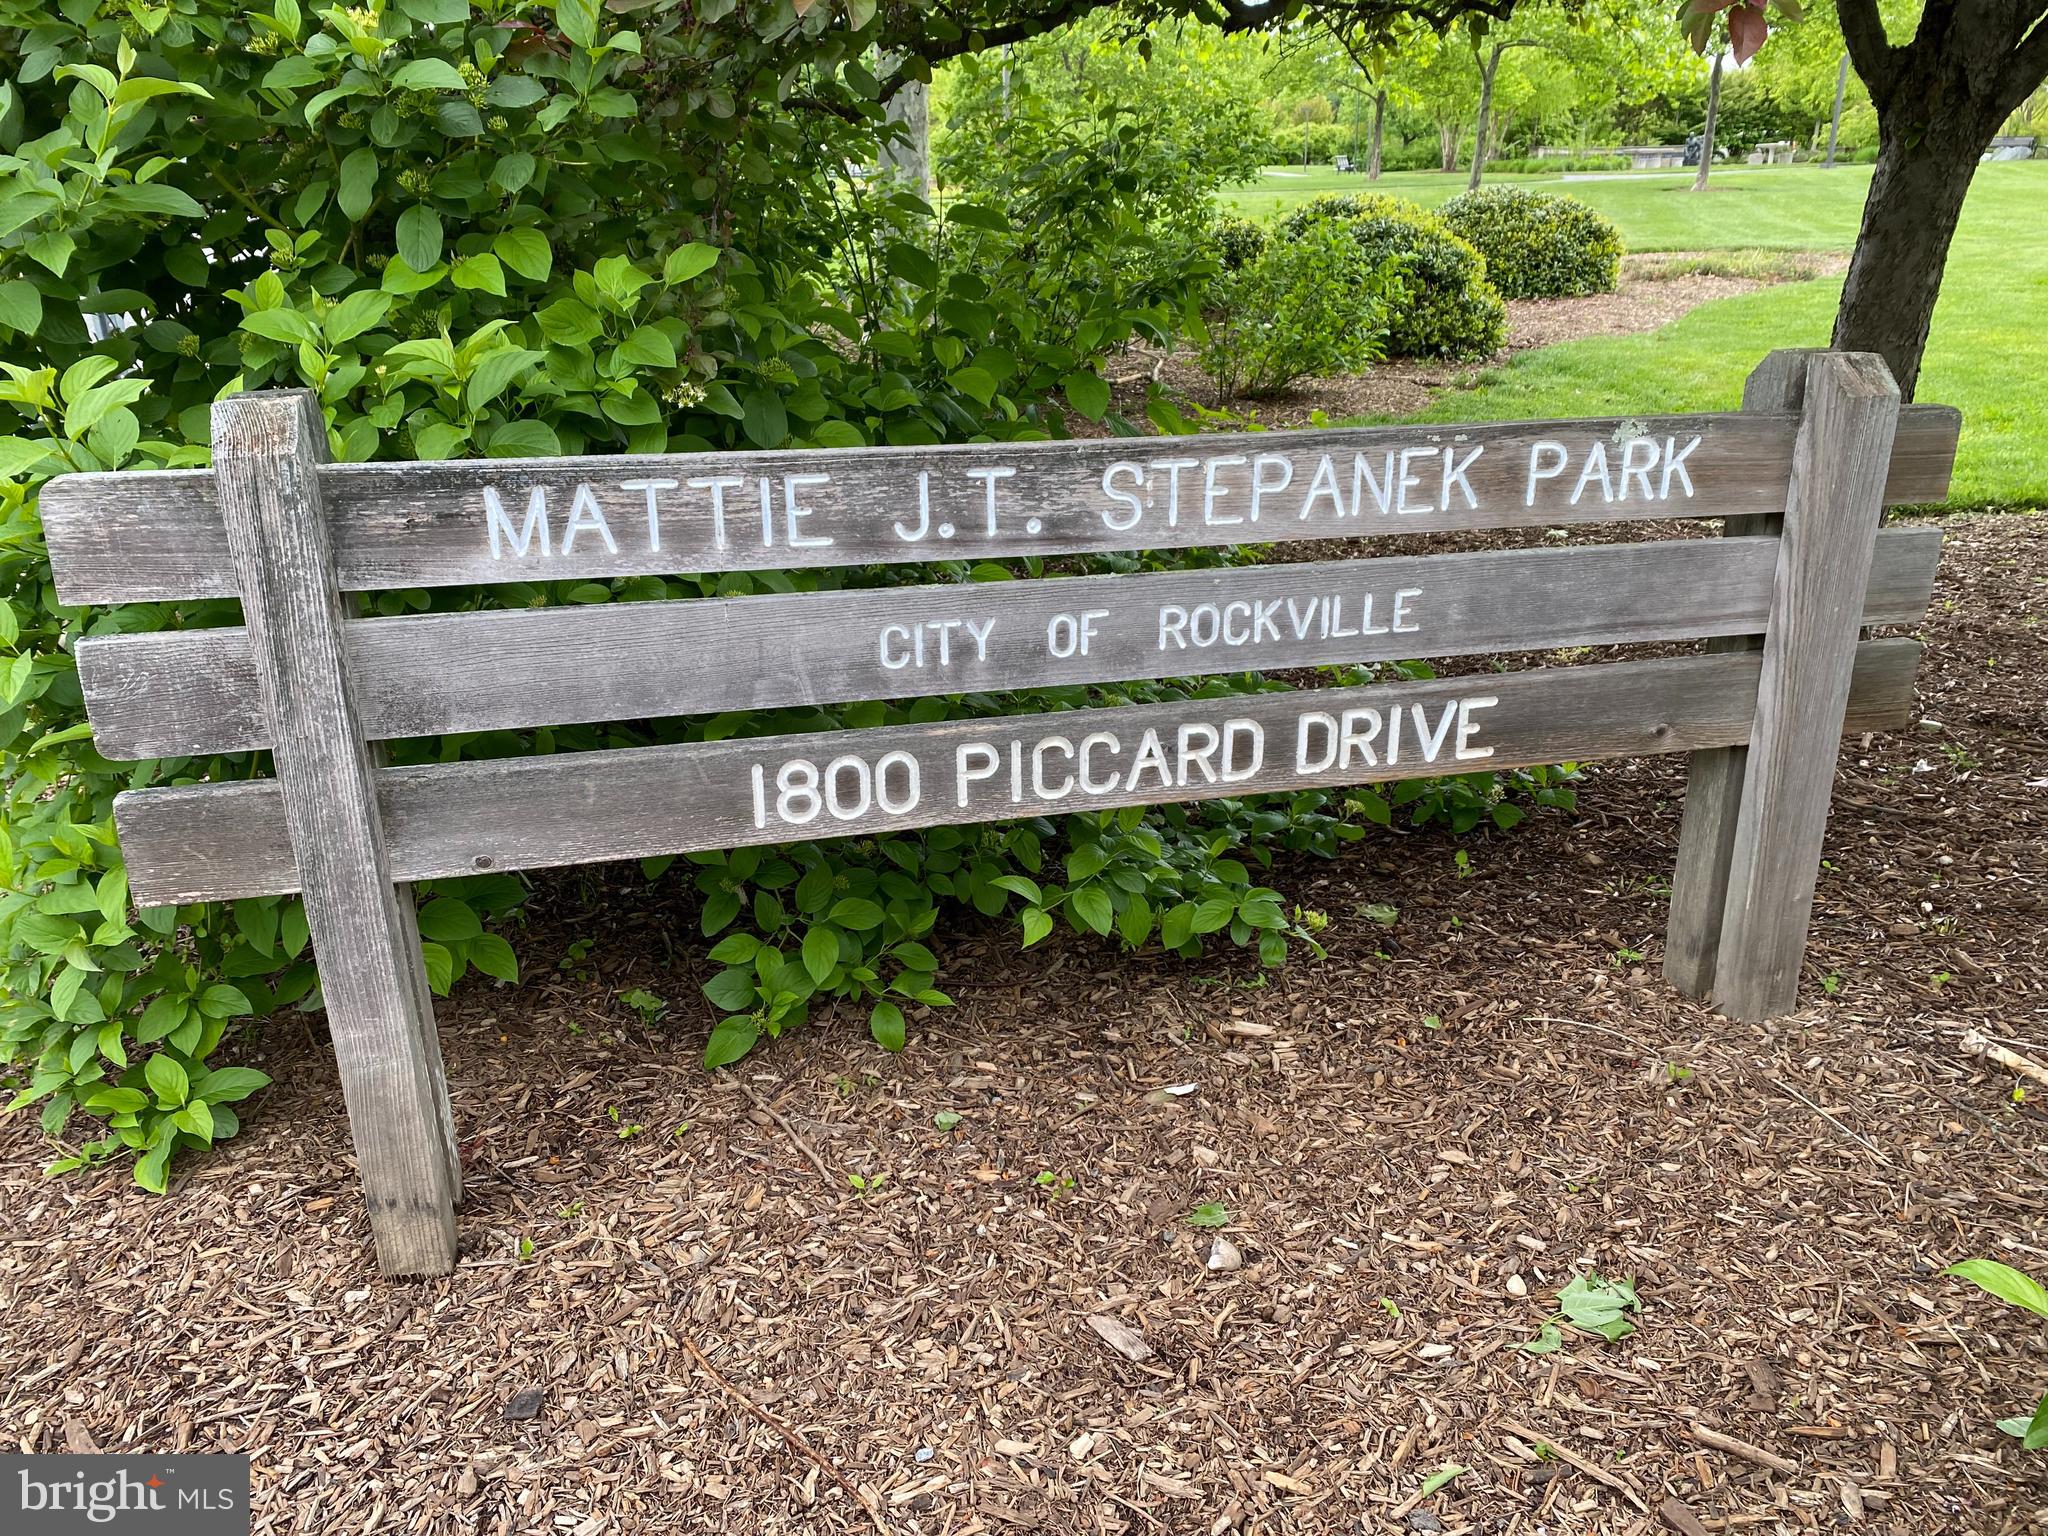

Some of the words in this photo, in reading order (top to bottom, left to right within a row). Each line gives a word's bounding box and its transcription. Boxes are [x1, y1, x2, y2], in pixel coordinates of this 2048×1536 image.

[483, 472, 834, 560] MATTIE
[894, 467, 1042, 542] J.T.
[1101, 445, 1485, 531] STEPANEK
[1526, 435, 1702, 507] PARK
[879, 617, 996, 669] CITY
[1047, 609, 1109, 658] OF
[1158, 587, 1423, 651] ROCKVILLE
[751, 751, 920, 829] 1800
[957, 718, 1264, 807] PICCARD
[1295, 696, 1498, 776] DRIVE
